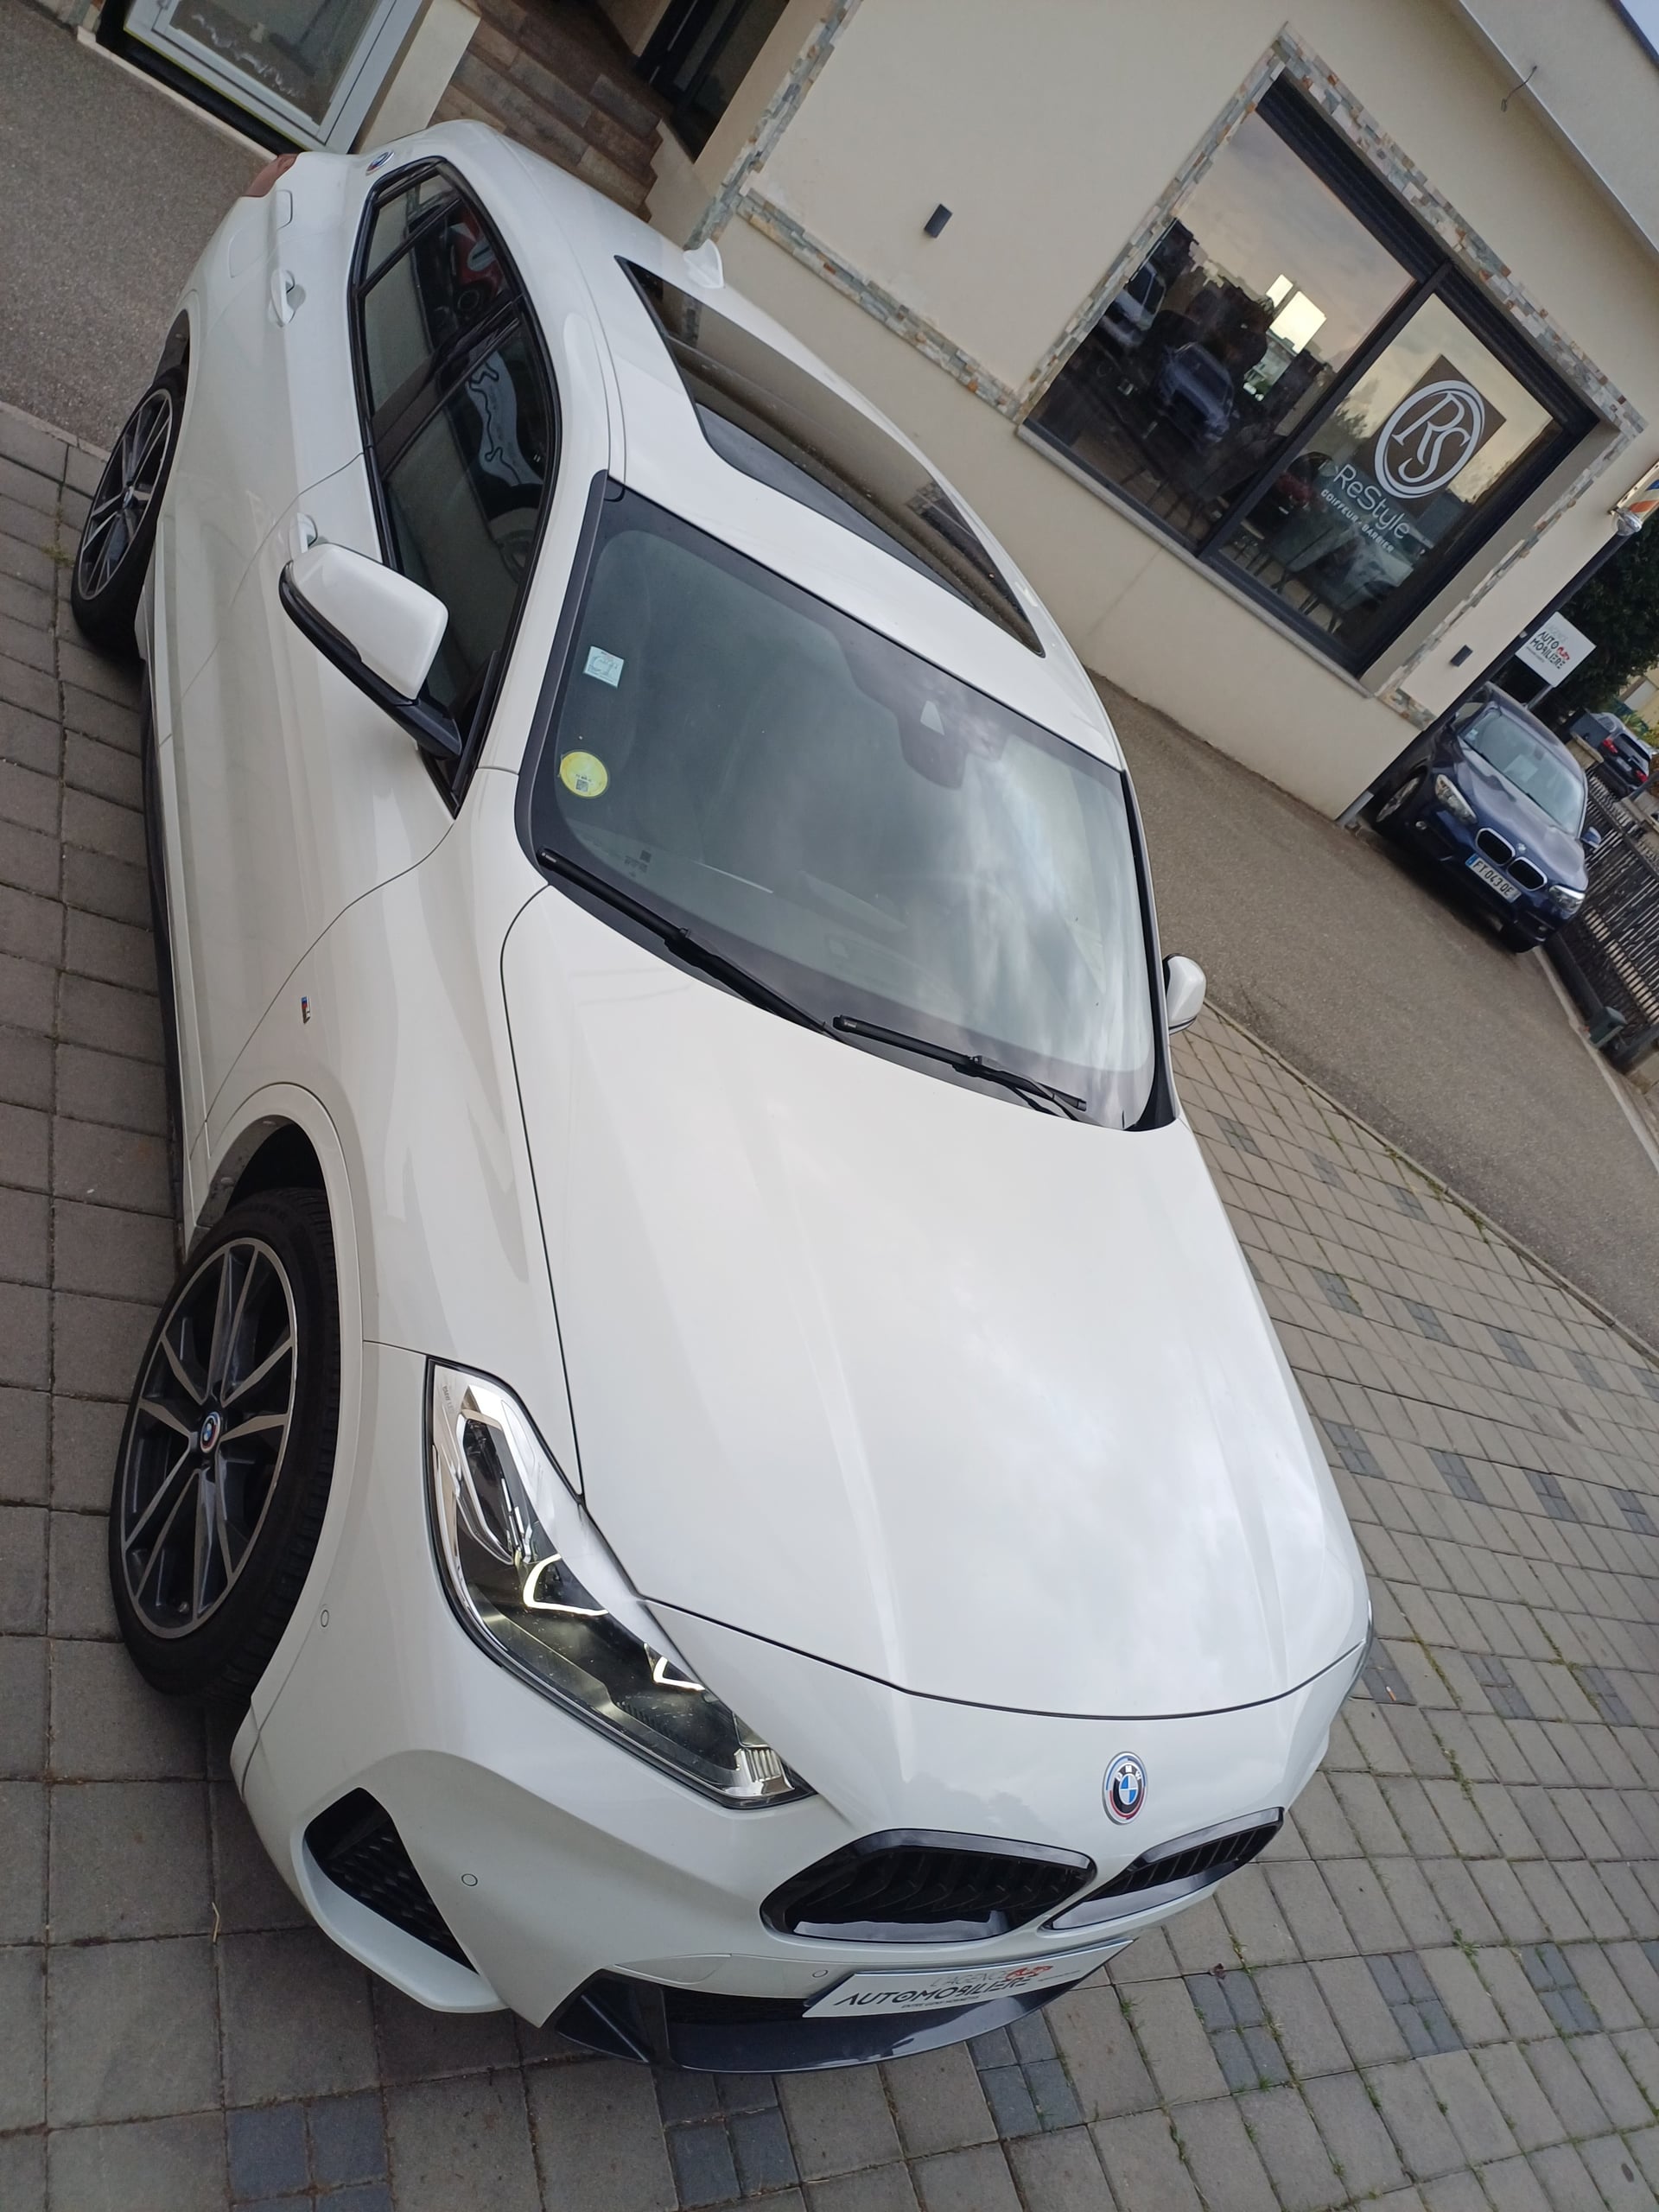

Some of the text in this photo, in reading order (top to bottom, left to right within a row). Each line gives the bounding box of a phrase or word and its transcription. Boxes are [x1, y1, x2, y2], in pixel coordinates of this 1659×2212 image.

[1320, 489, 1359, 522] COIFFEUR
[1362, 524, 1395, 553] BARBIER
[1333, 463, 1410, 539] ReStyle
[1538, 631, 1560, 650] AUTO
